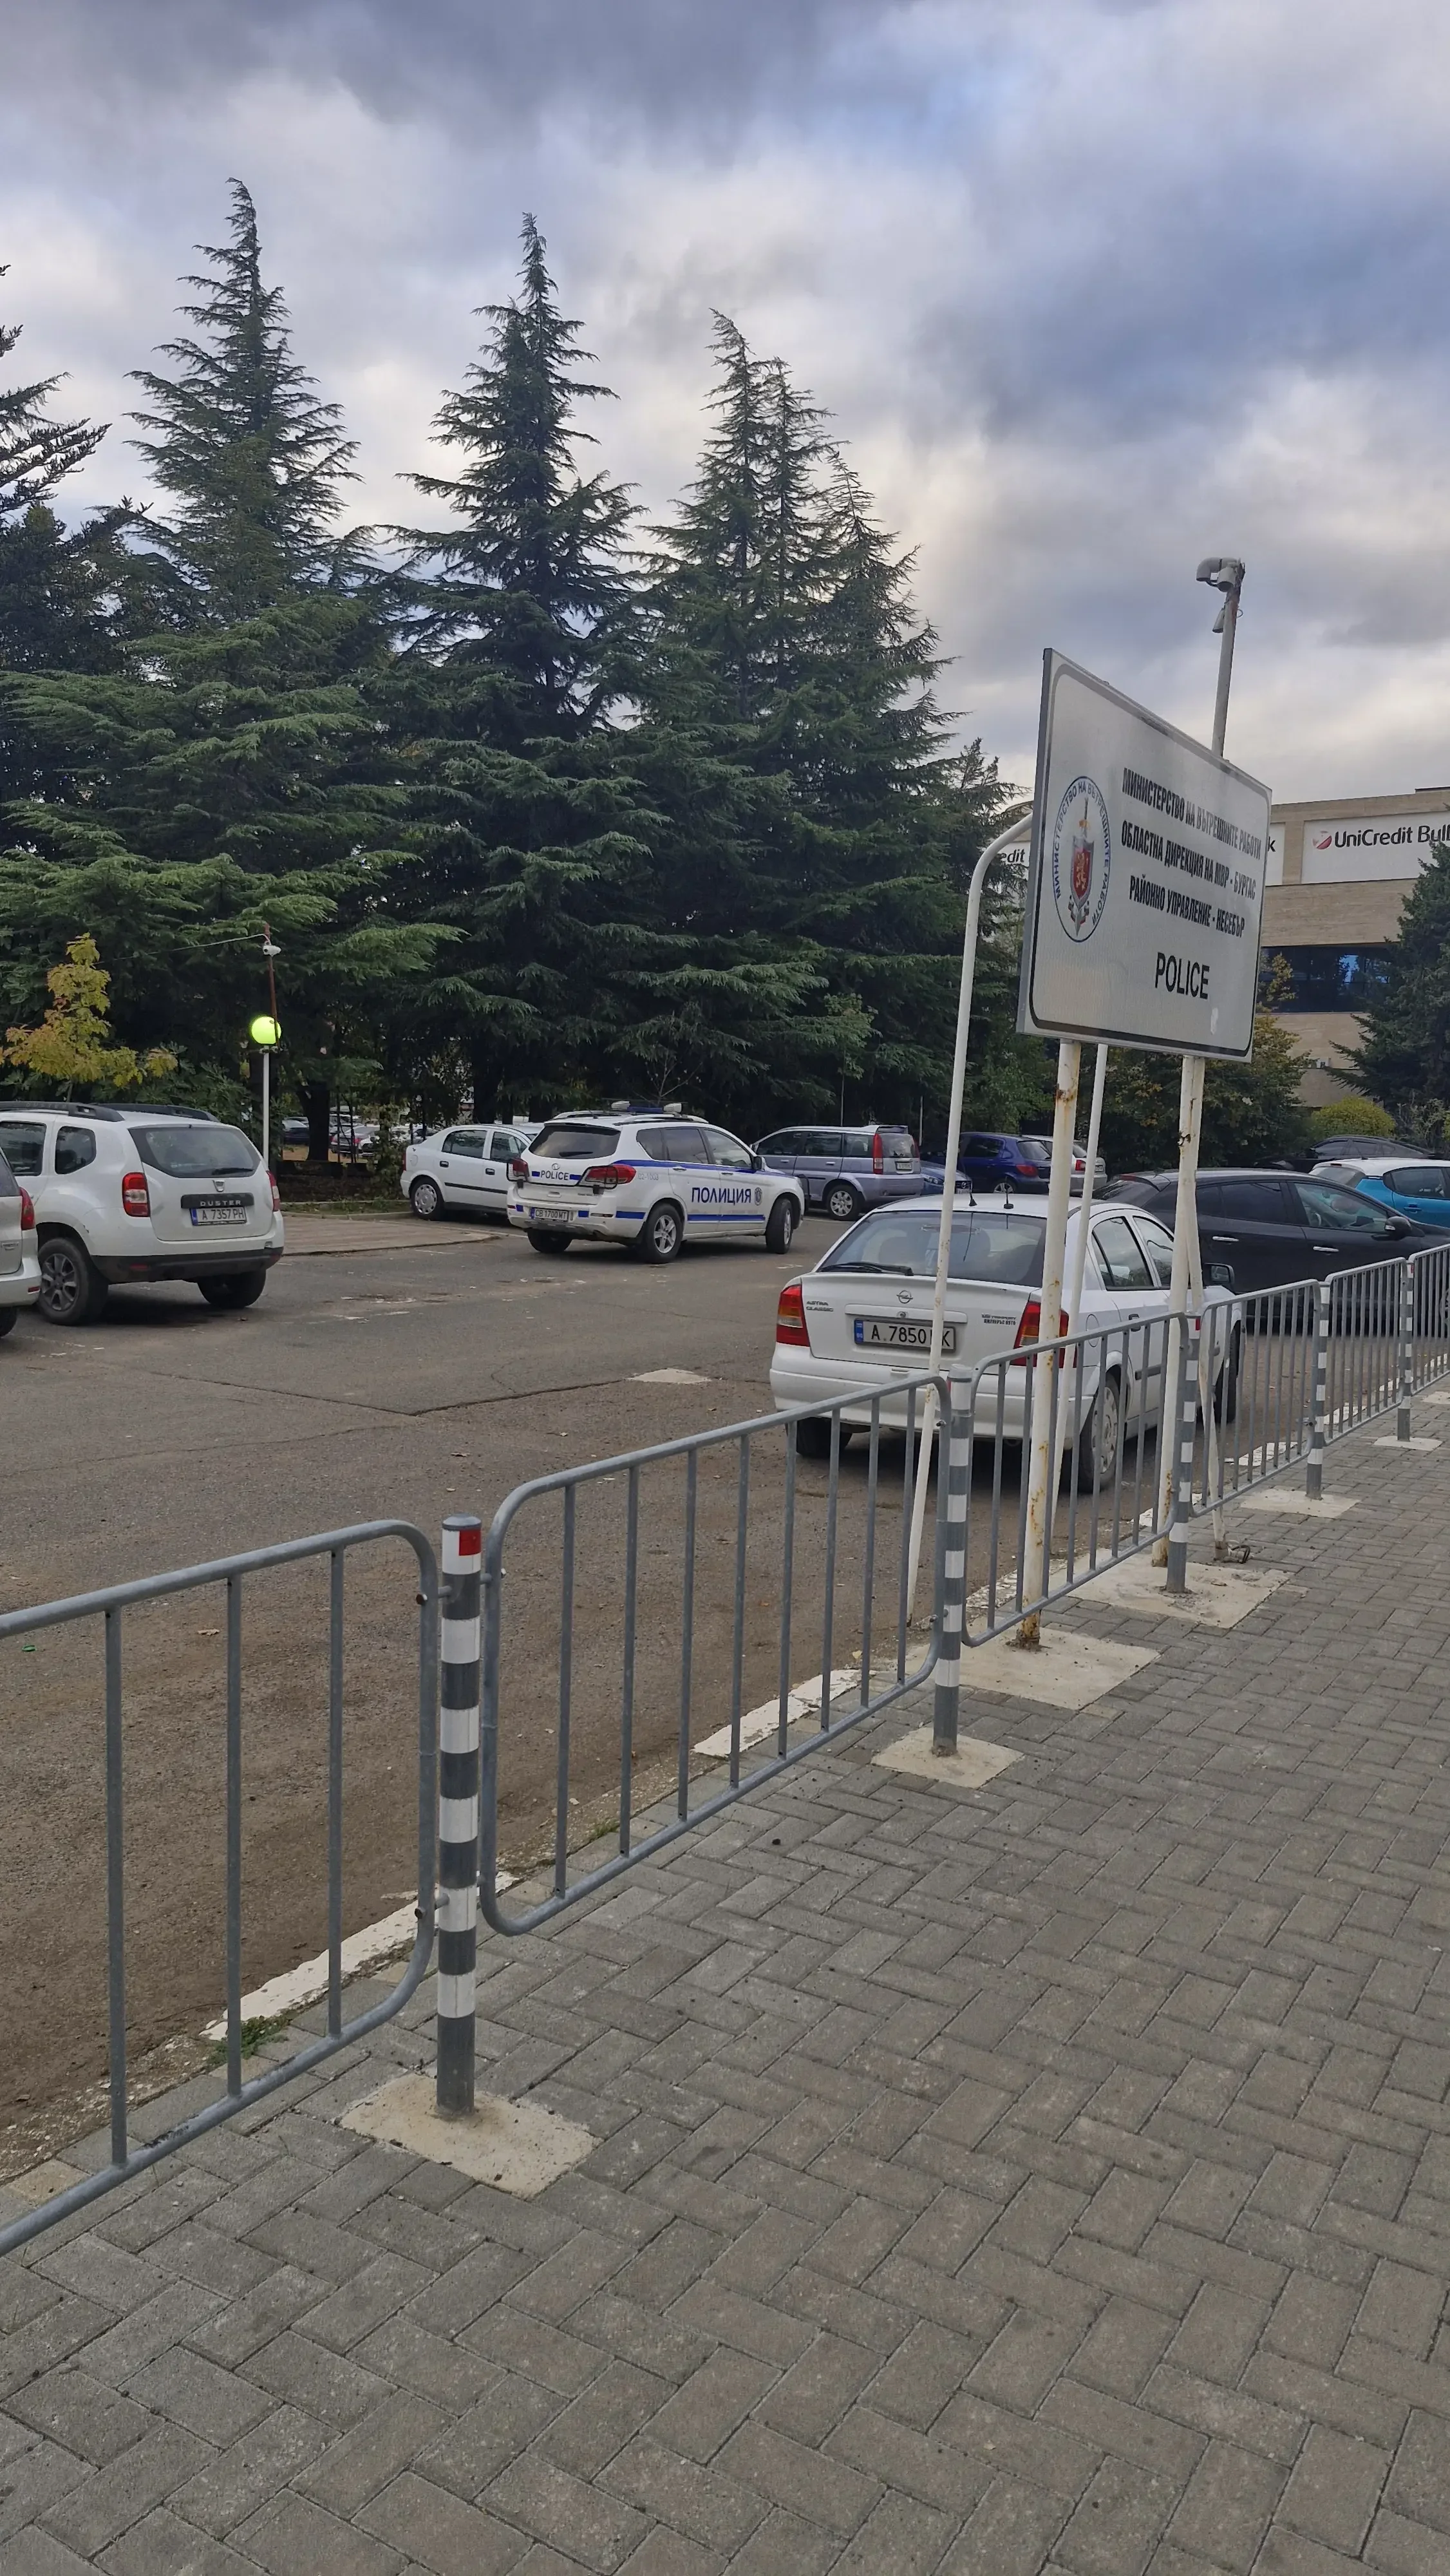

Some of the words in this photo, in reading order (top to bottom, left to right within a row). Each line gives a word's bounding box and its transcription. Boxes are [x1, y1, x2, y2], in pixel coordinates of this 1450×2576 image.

[1122, 767, 1185, 822] МИНИСТЕРСТВО
[1185, 800, 1195, 828] НА
[1196, 806, 1238, 849] ВЪТРЕШНИТЕ
[1239, 829, 1261, 860] РАБОТИ
[1335, 827, 1413, 848] UniCredit
[1122, 820, 1163, 862] ОБЛАСТНА
[1164, 840, 1204, 877] ДИРЕКЦИЯ
[1204, 857, 1214, 883] НА
[1214, 862, 1230, 888] МВР
[1234, 871, 1256, 900] БУРГАС
[1129, 874, 1165, 911] РАЙОННО
[1166, 889, 1212, 927] УПРАВЛЕНИЕ
[1216, 907, 1245, 938] НЕСЕБЪР
[1154, 951, 1210, 999] POLICE
[541, 1170, 569, 1180] POLICE
[692, 1187, 751, 1206] ПОЛИЦИЯ
[211, 1208, 231, 1220] 7357
[871, 1325, 880, 1340] A
[889, 1325, 927, 1344] 7850
